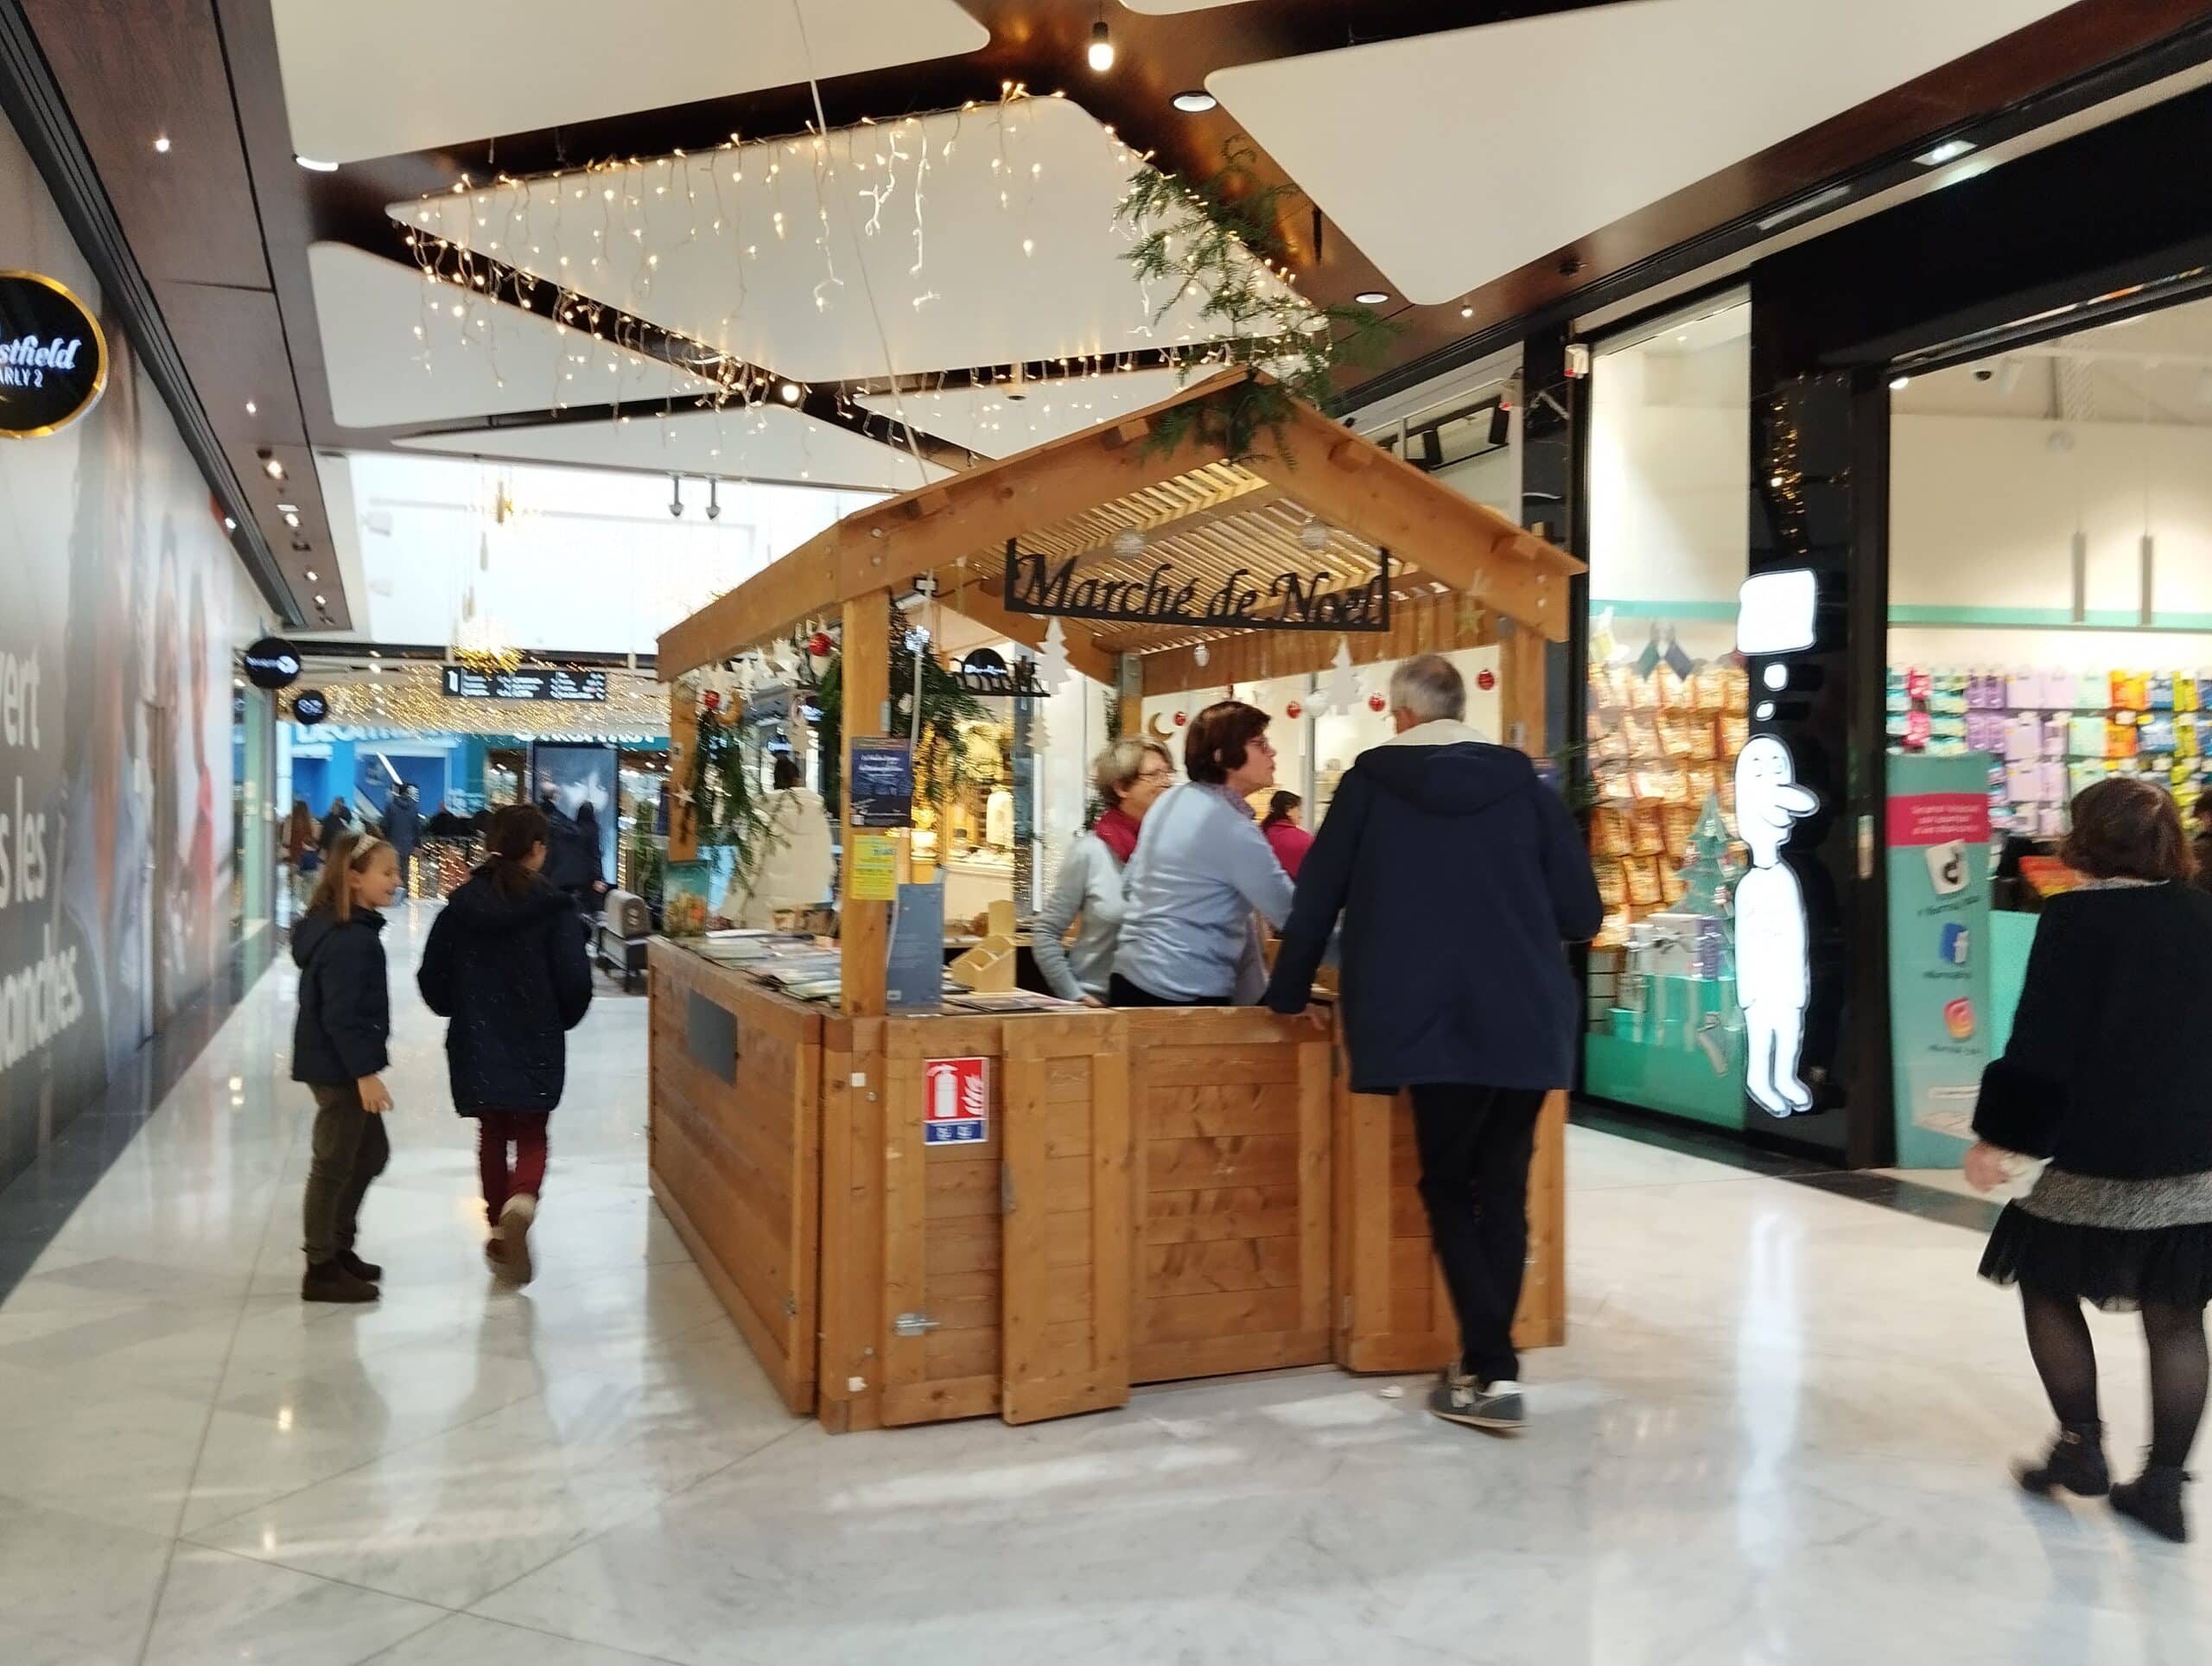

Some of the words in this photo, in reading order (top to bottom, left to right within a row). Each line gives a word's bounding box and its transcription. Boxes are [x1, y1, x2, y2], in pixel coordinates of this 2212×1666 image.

[1014, 553, 1200, 617] Marché
[1210, 568, 1259, 618] de
[16, 775, 48, 903] les
